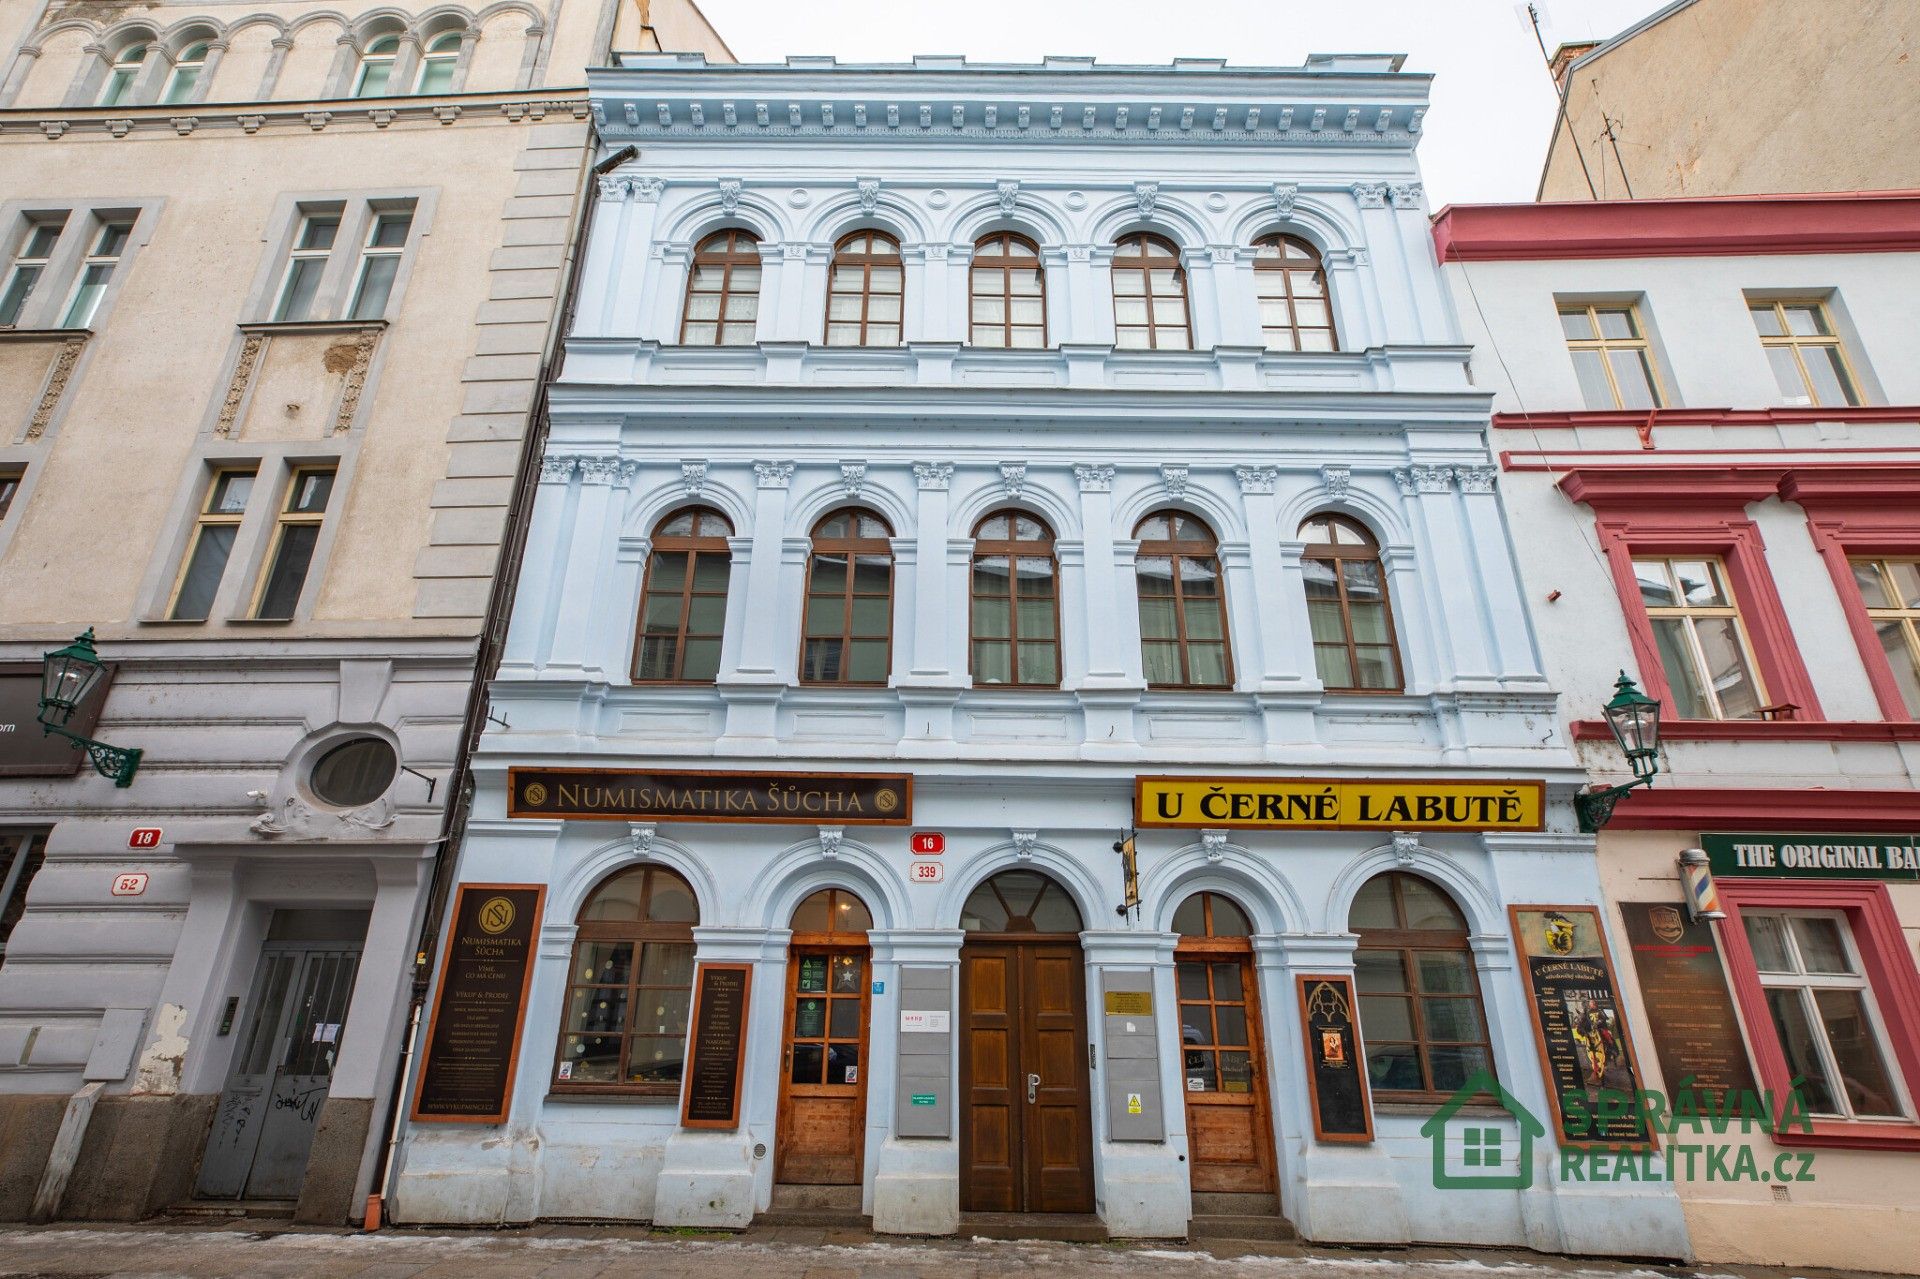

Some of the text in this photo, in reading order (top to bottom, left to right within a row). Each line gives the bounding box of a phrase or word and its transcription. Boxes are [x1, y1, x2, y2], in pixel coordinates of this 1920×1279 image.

[557, 782, 865, 812] NUMISMATIKA ŠŮCHA
[1156, 786, 1523, 822] U ČERNÉ LABUTĚ
[136, 832, 153, 844] 18
[922, 837, 934, 849] 16
[1733, 844, 1920, 869] THE ORIGINAL BA
[918, 866, 936, 878] 339
[120, 878, 138, 890] 52
